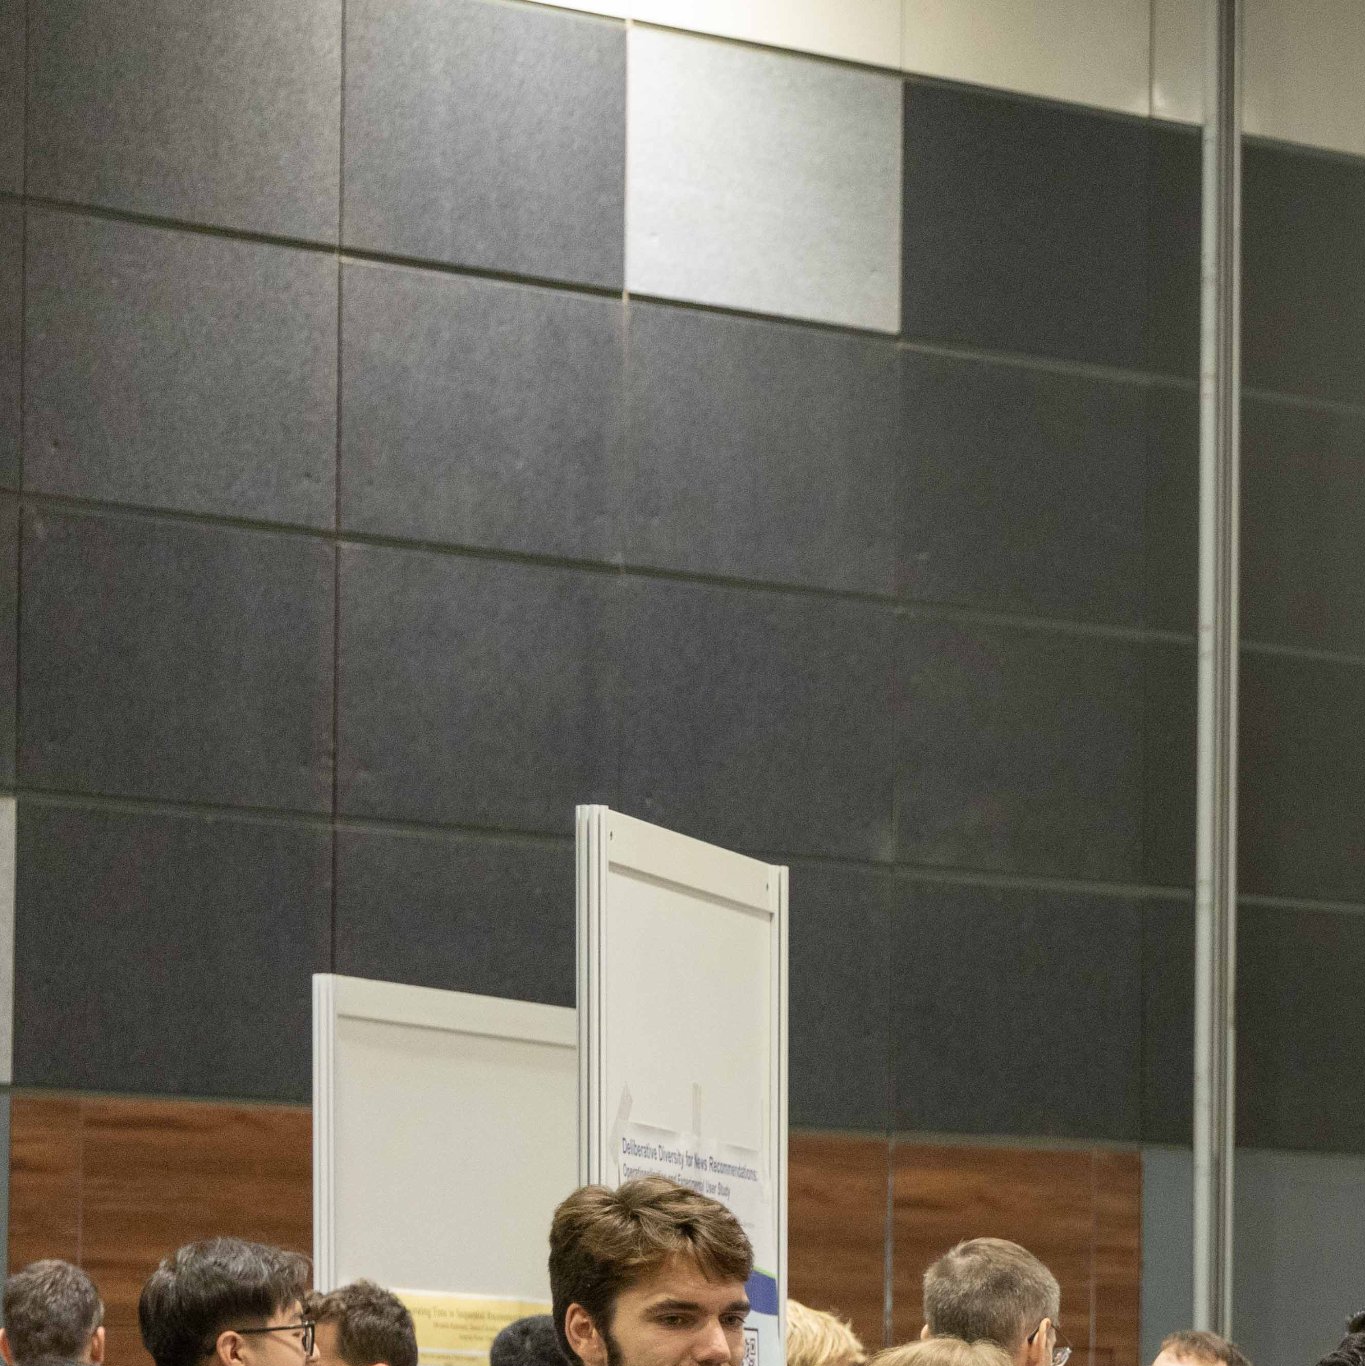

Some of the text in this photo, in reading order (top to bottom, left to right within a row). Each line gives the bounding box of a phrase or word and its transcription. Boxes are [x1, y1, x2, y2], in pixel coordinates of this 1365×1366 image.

[622, 1137, 657, 1161] Deliberative
[658, 1144, 684, 1170] Diversity
[685, 1150, 694, 1167] for
[694, 1153, 708, 1171] News
